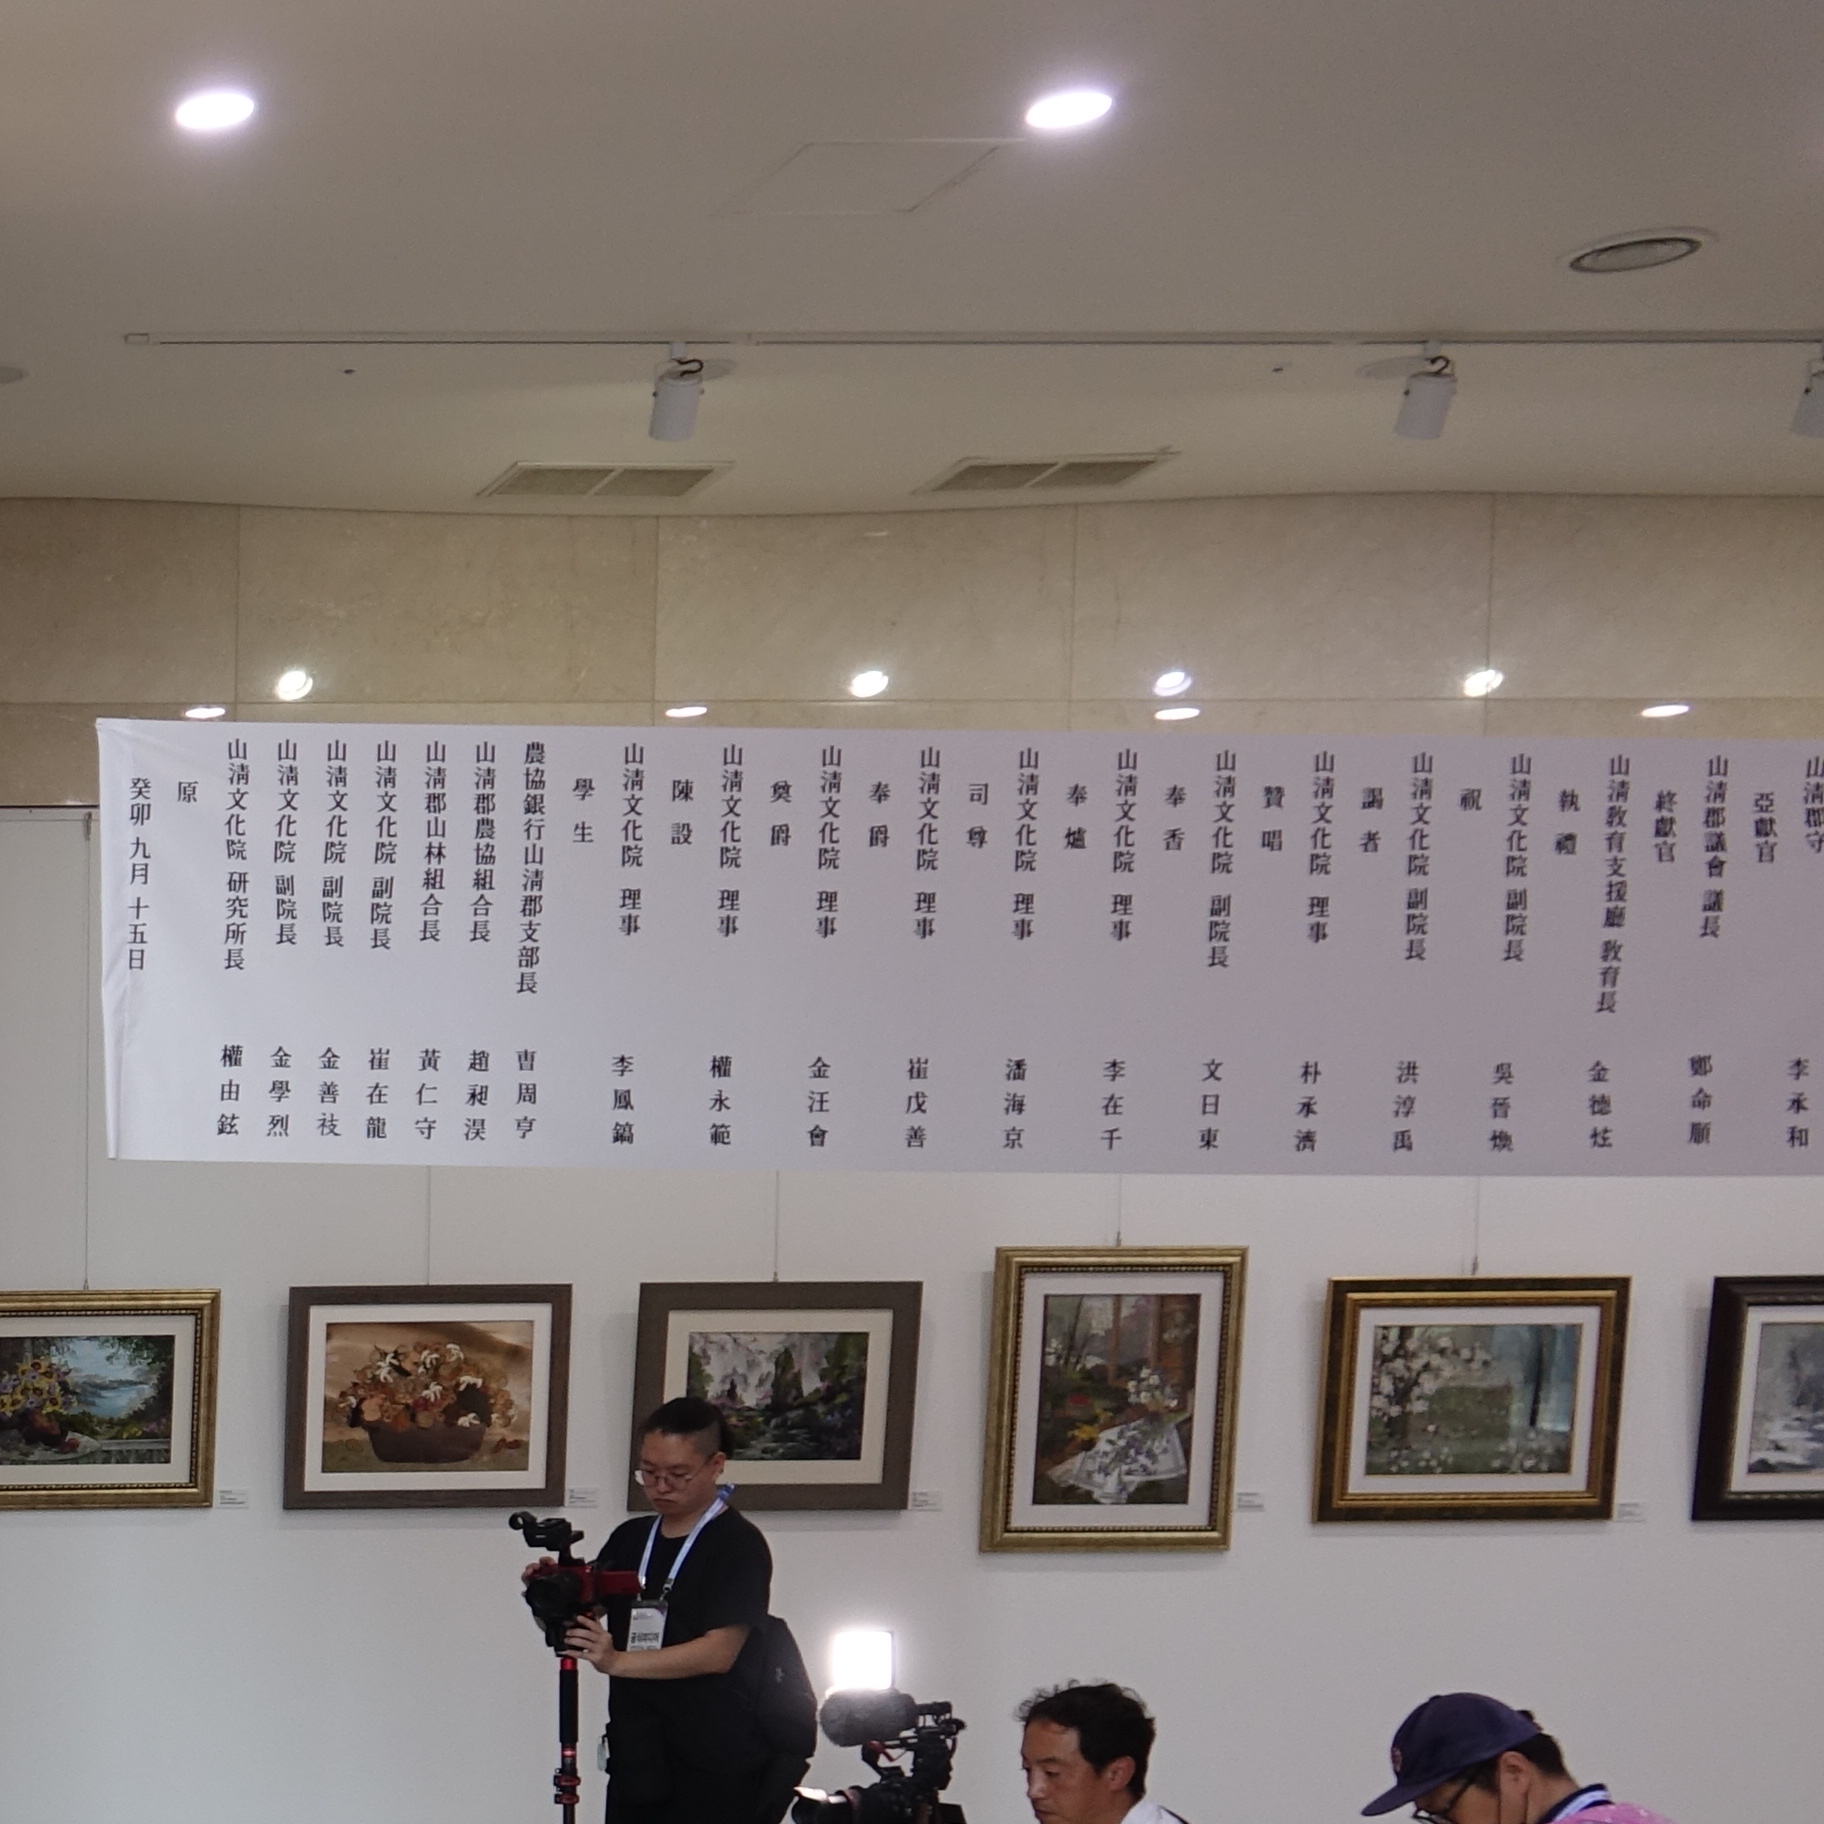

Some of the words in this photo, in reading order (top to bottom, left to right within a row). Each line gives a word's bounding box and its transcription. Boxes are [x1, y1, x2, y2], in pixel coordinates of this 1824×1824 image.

[130, 778, 151, 826] 癸卯
[177, 781, 198, 803] 原
[572, 778, 595, 843] 學生
[671, 779, 693, 845] 陳設
[1163, 784, 1186, 851] 奉香
[130, 836, 151, 885] 九月
[127, 897, 149, 970] 十五日
[275, 875, 297, 945] 副院長
[322, 875, 344, 947] 副院長
[370, 876, 394, 950] 副院長
[619, 888, 641, 936] 理事
[717, 889, 740, 937] 理事
[815, 891, 838, 939] 理事
[913, 892, 936, 939] 理事
[1012, 893, 1035, 940] 理事
[1111, 894, 1133, 941] 理事
[1208, 894, 1231, 968] 副院長
[1306, 896, 1329, 943] 理事
[1405, 888, 1428, 961] 副院長
[1502, 888, 1528, 962] 副院長
[1699, 889, 1724, 938] 議長
[366, 1047, 390, 1139] 崔在龍
[1101, 1059, 1125, 1150] 李在千
